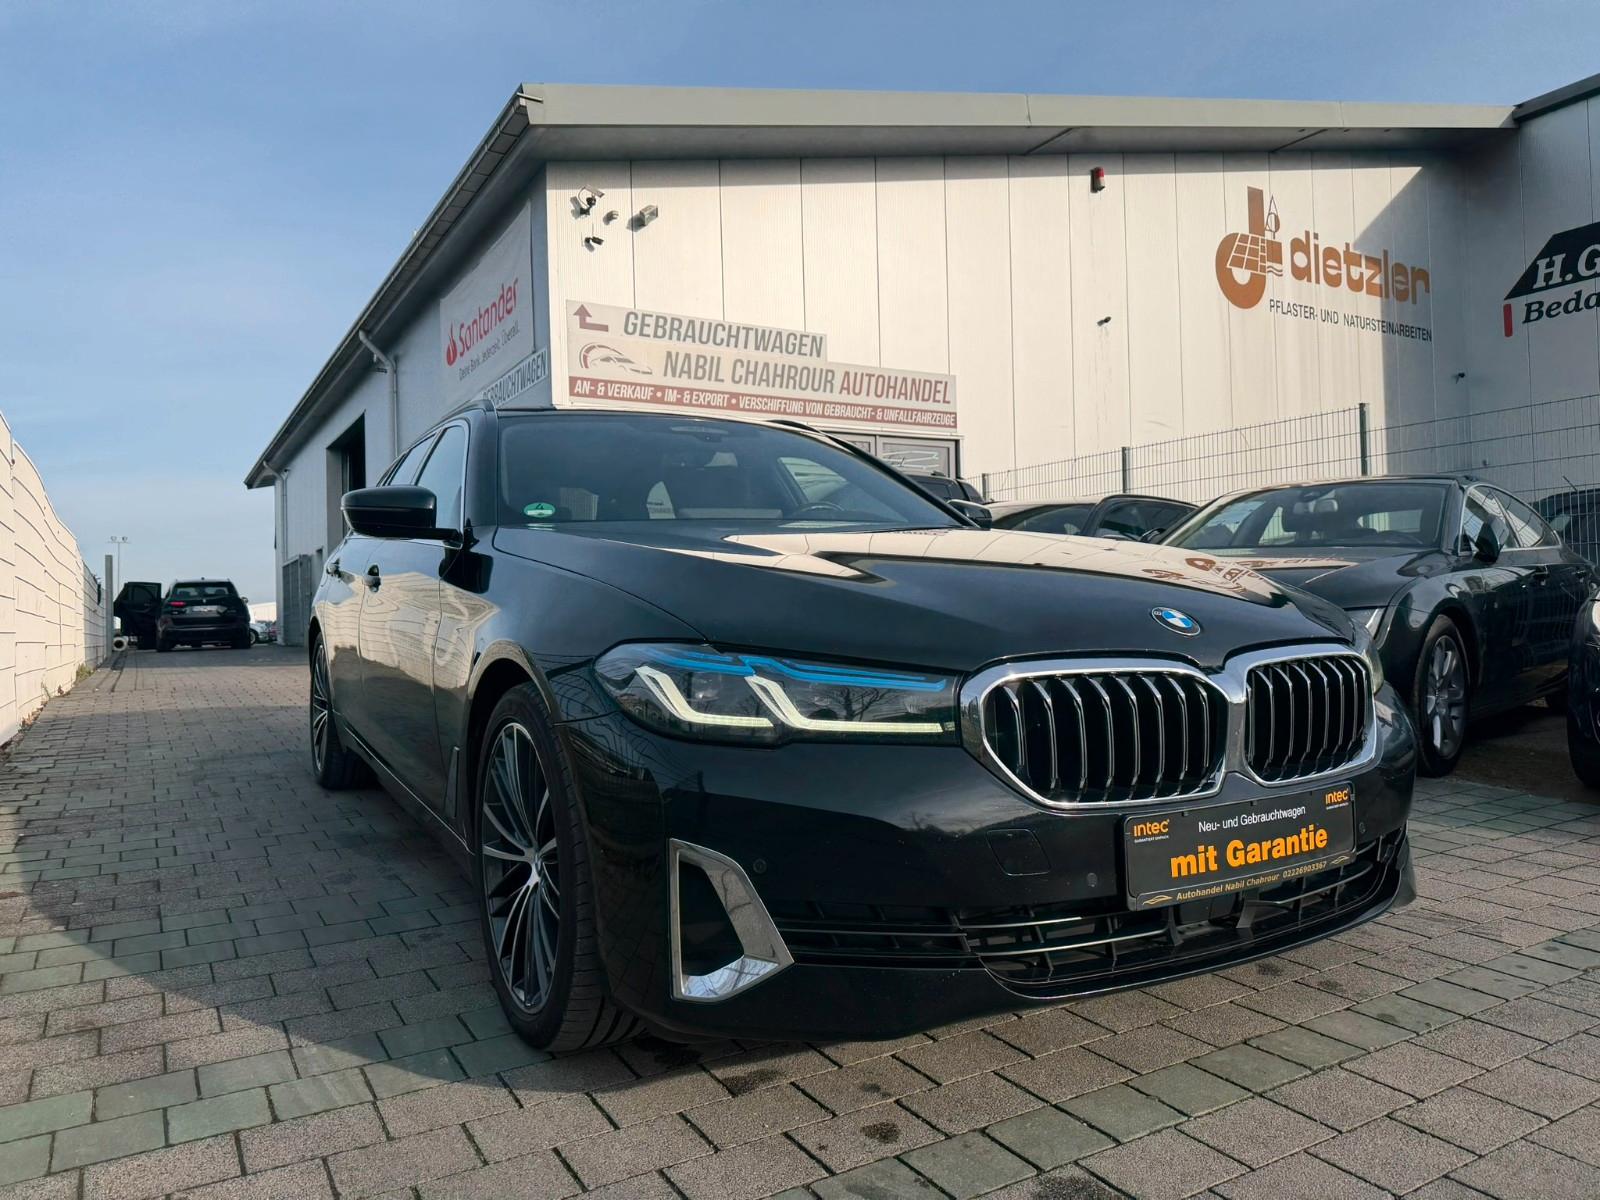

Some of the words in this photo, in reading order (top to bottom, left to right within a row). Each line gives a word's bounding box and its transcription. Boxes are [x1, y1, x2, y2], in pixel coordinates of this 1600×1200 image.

[1290, 230, 1430, 305] dietzler
[459, 277, 519, 358] Santander
[623, 311, 823, 358] GEBRAUCHTWAGEN
[1269, 299, 1318, 320] PFLASTER-
[1320, 309, 1339, 325] UND
[1343, 313, 1432, 342] NATURSTEINARBEITEN
[663, 350, 725, 382] NABIL
[731, 358, 835, 394] CHAHROUR
[839, 371, 951, 405] AUTOHANDEL
[574, 379, 595, 396] AN-
[597, 383, 606, 396] &
[607, 382, 654, 400] VERKAUF
[664, 388, 681, 402] IM-
[683, 391, 692, 404] &
[692, 391, 730, 407] EXPORT
[738, 395, 803, 414] VERSCHIFFUNG
[805, 401, 824, 416] VON
[824, 404, 875, 420] GEBRAUCHT-
[876, 409, 883, 420] &
[884, 409, 955, 426] UNFALLFAHRZEUGE
[1198, 820, 1221, 833] Neu-
[1222, 815, 1238, 829] und
[1240, 806, 1306, 826] Gebrauchtwagen
[1325, 789, 1349, 805] intec
[1133, 820, 1169, 837] intec
[1170, 845, 1218, 878] mit
[1226, 824, 1328, 867] Garantie
[1176, 885, 1222, 901] Autohandel
[1225, 880, 1245, 892] Nabil
[1246, 873, 1280, 887] Chahrour
